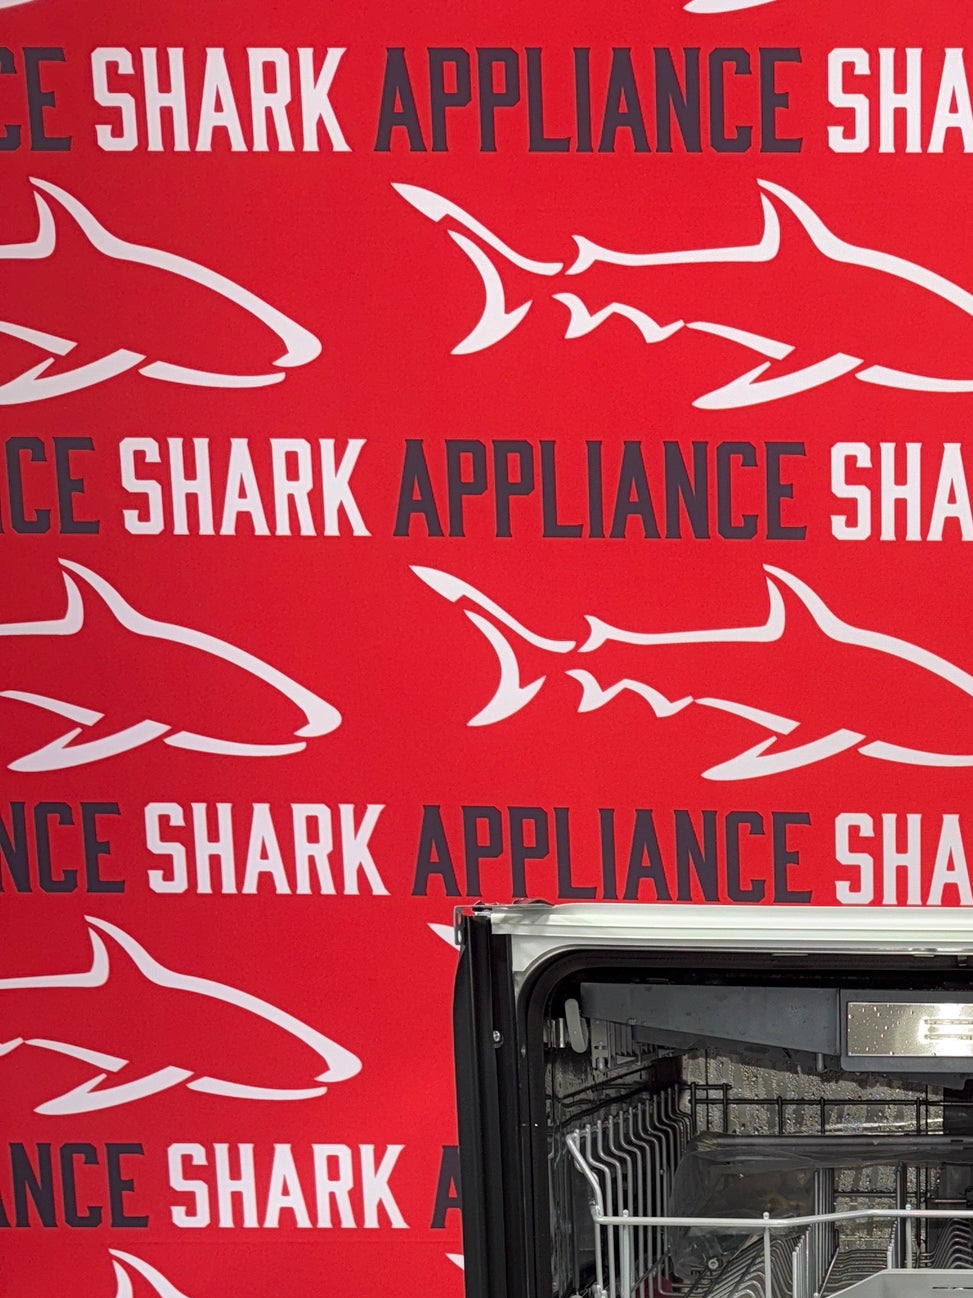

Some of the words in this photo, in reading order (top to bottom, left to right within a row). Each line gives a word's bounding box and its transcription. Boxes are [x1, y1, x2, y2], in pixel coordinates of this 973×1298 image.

[92, 47, 351, 152] SHARK
[375, 47, 802, 153] APPLIANCE
[0, 437, 99, 535] CE
[120, 437, 371, 536] SHARK
[394, 440, 806, 541] APPLIANCE
[145, 802, 389, 896] SHARK
[412, 806, 812, 904] APPLIANCE
[0, 1143, 148, 1228] NCE
[168, 1143, 410, 1229] SHARK
